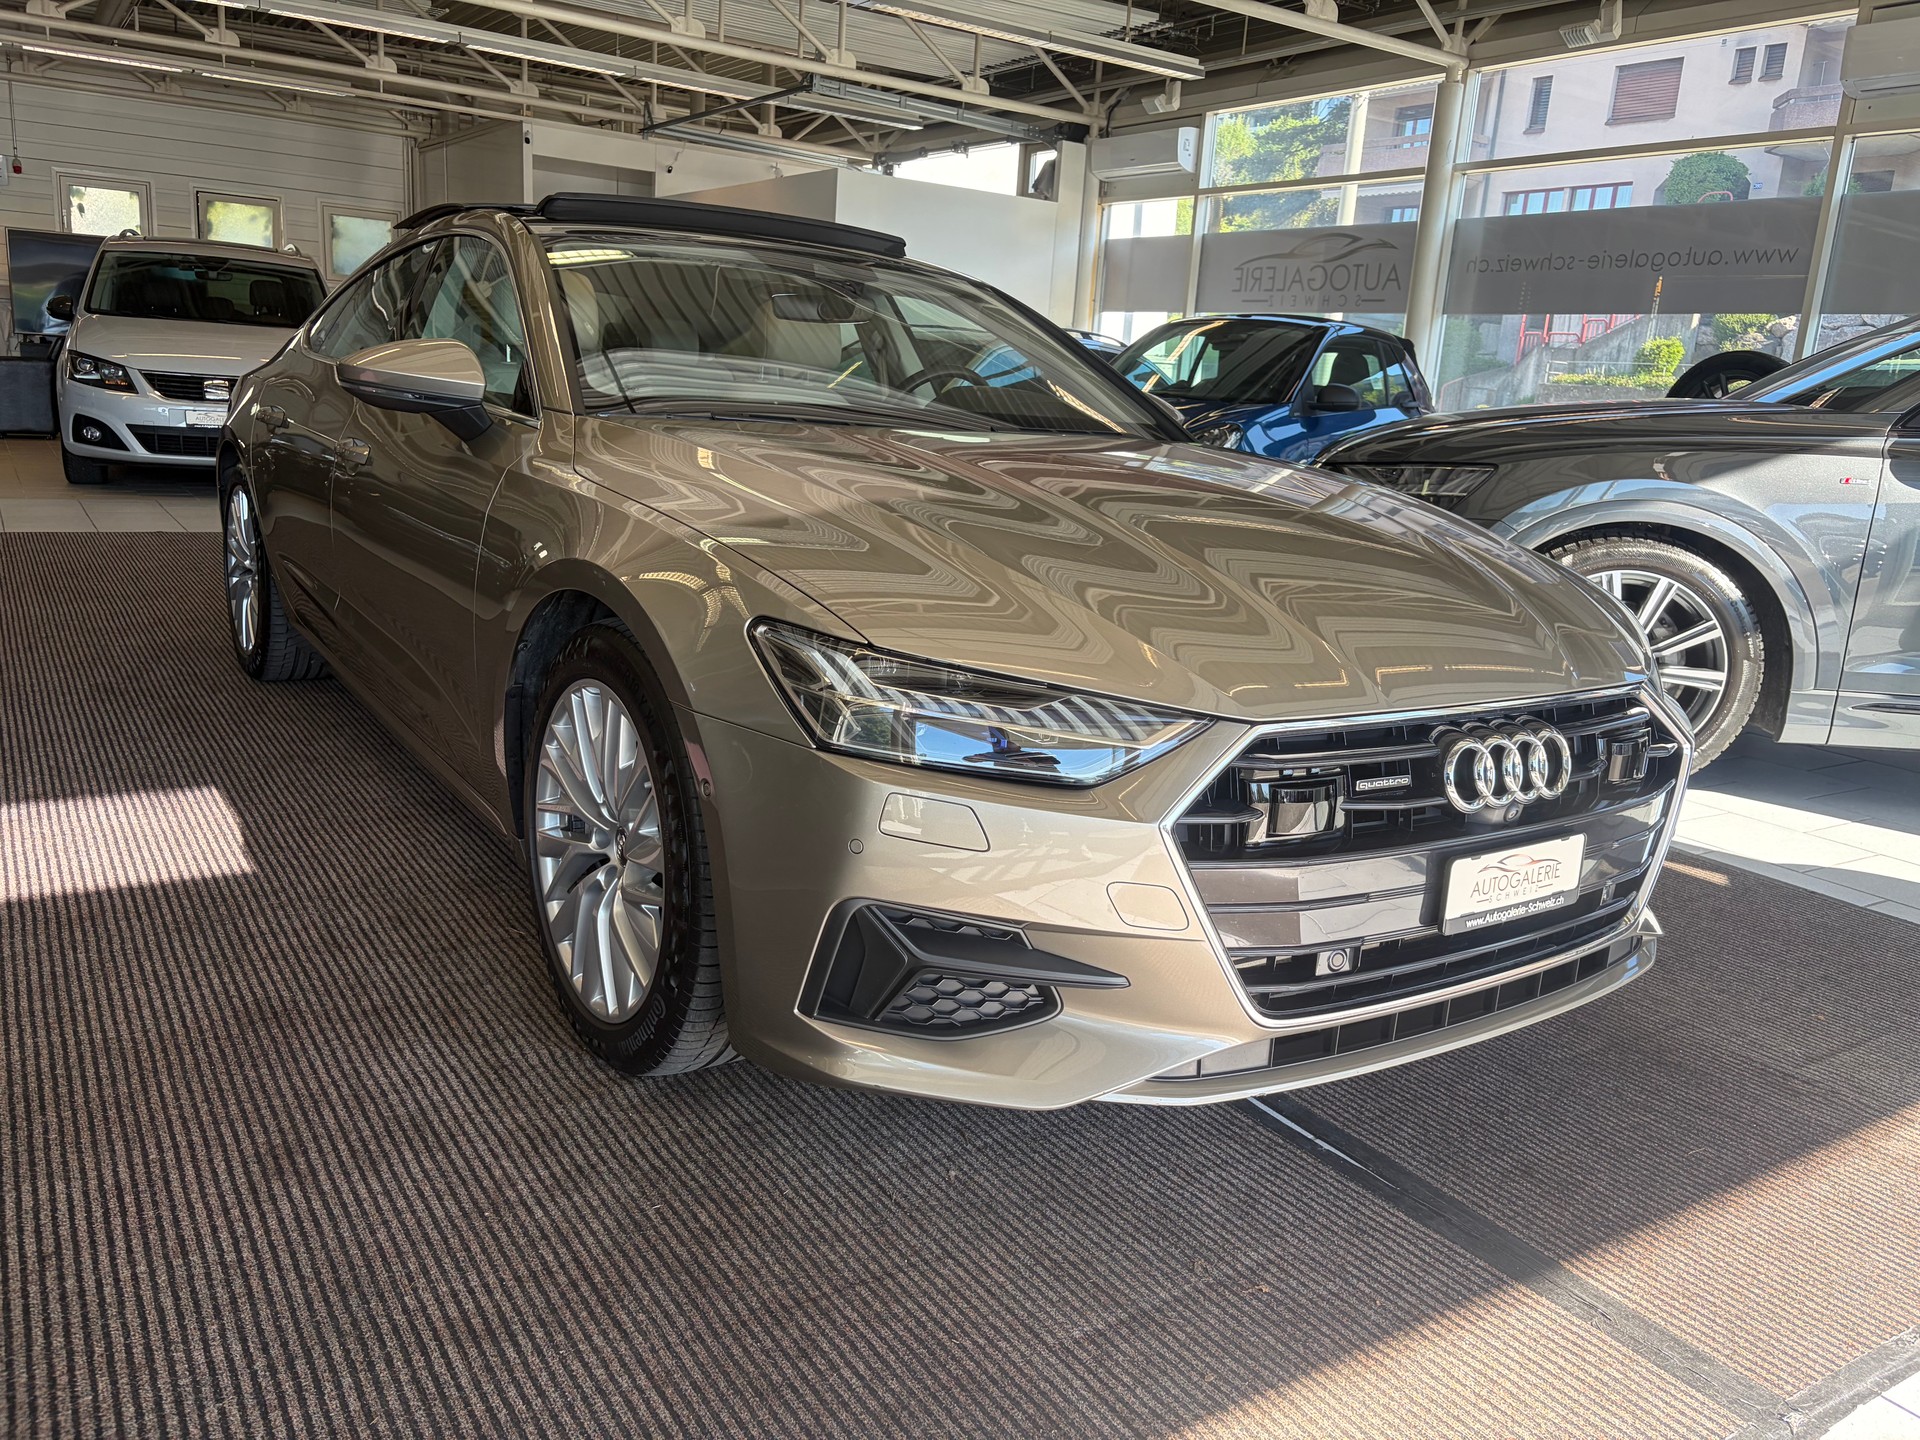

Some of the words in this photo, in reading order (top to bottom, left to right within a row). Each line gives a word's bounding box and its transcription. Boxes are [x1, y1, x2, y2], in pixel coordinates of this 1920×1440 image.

[1359, 777, 1409, 790] quattro
[1470, 863, 1561, 898] AUTOGALERIE
[1488, 884, 1539, 903] SCHWEIZ
[1465, 895, 1565, 928] www.Autogalerie-Schweiz.ch
[619, 992, 667, 1057] Continental
